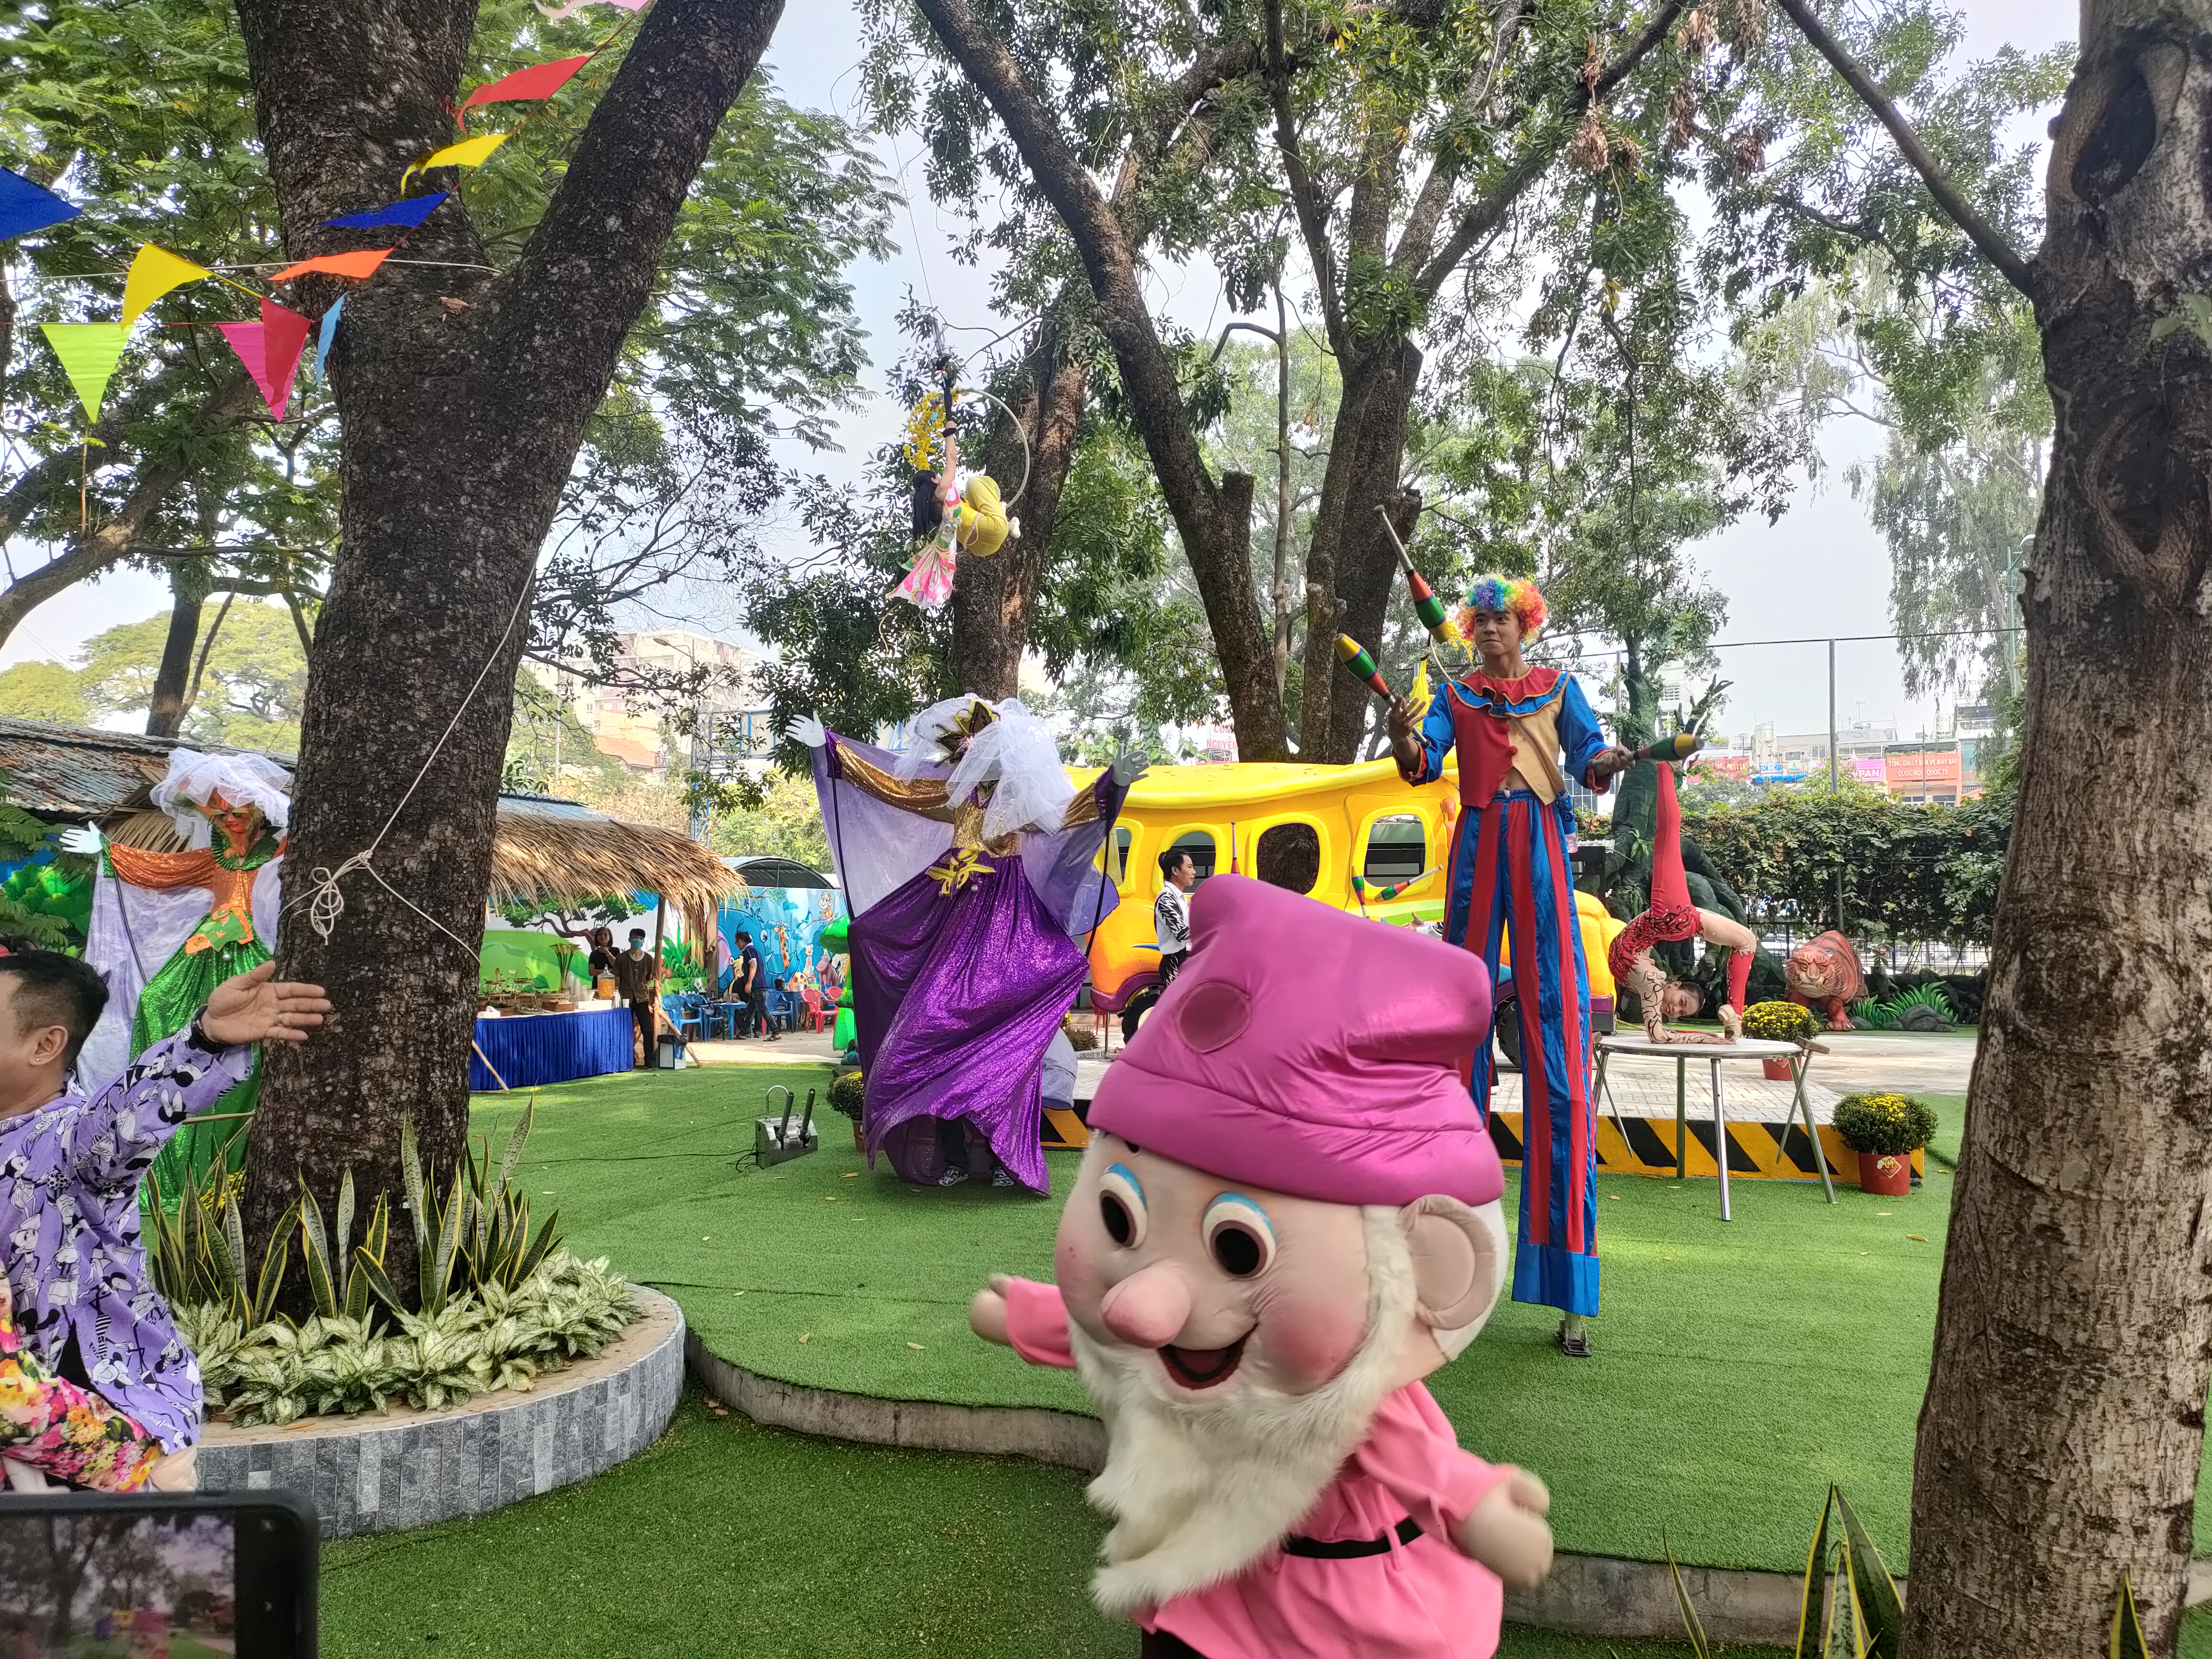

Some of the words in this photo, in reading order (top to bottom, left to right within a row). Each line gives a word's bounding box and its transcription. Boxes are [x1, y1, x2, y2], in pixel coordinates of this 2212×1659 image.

[1888, 758, 1902, 767] TỔNG
[1903, 759, 1911, 767] ĐẠI
[1912, 758, 1918, 766] LÝ
[1936, 757, 1947, 765] MÁY
[1898, 768, 1913, 777] QUỐC
[1913, 768, 1923, 777] NỘI
[1926, 767, 1941, 776] QUỐC
[1942, 766, 1949, 775] TẾ
